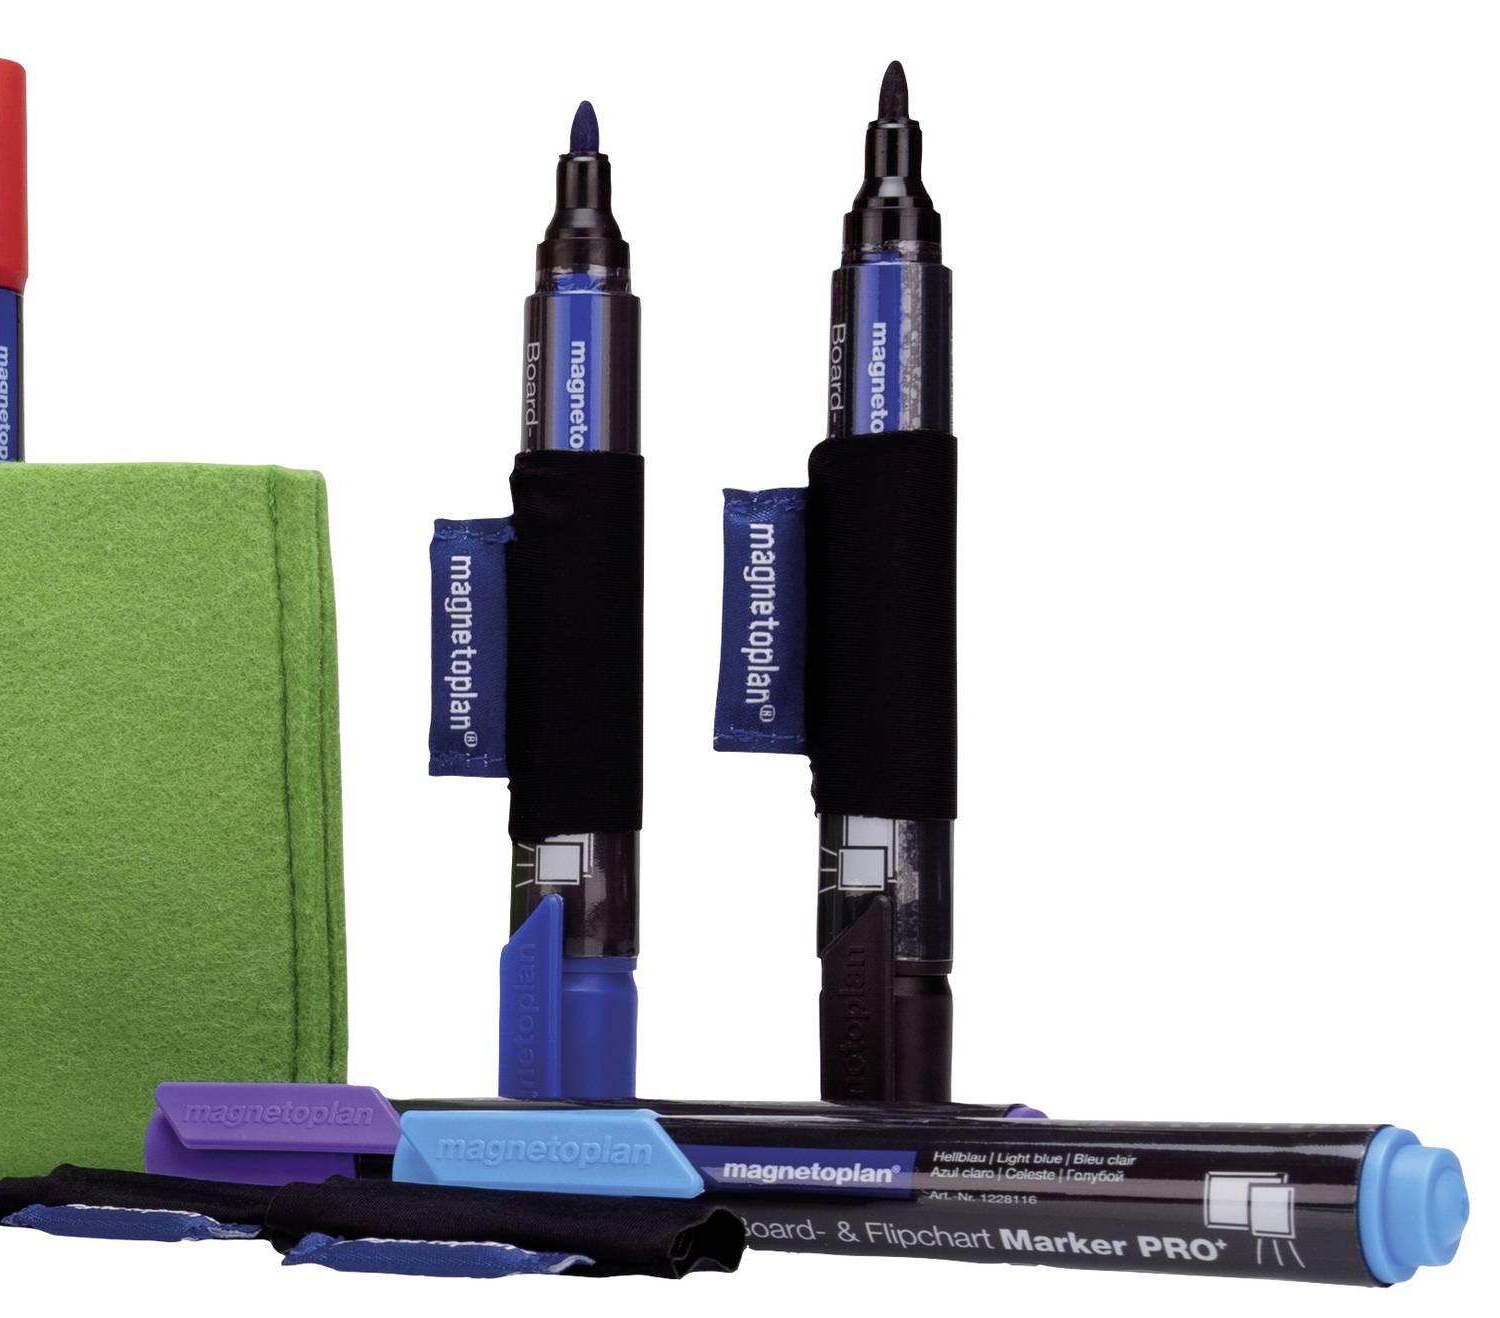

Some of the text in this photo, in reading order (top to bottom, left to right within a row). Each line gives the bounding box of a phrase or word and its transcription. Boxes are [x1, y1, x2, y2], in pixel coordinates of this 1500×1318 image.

[830, 323, 846, 423] Board-
[868, 322, 888, 433] magneto
[525, 342, 540, 437] Board-
[566, 341, 588, 451] magneto
[182, 1099, 374, 1130] magnetoplan
[437, 1136, 652, 1167] magnetoplan
[933, 1152, 987, 1164] Hellblau
[997, 1153, 1031, 1166] Light
[1034, 1154, 1063, 1165] blue
[1074, 1154, 1104, 1166] Bleu
[1108, 1154, 1137, 1166] clair
[930, 1167, 959, 1179] Azul
[962, 1168, 994, 1179] claro
[1005, 1168, 1055, 1180] Celeste
[1066, 1168, 1124, 1184] Голубой
[929, 1191, 1037, 1205] Art.-Nr. 1228116
[837, 1221, 860, 1243] &
[865, 1222, 995, 1249] Flipchart
[999, 1228, 1127, 1257] Marker
